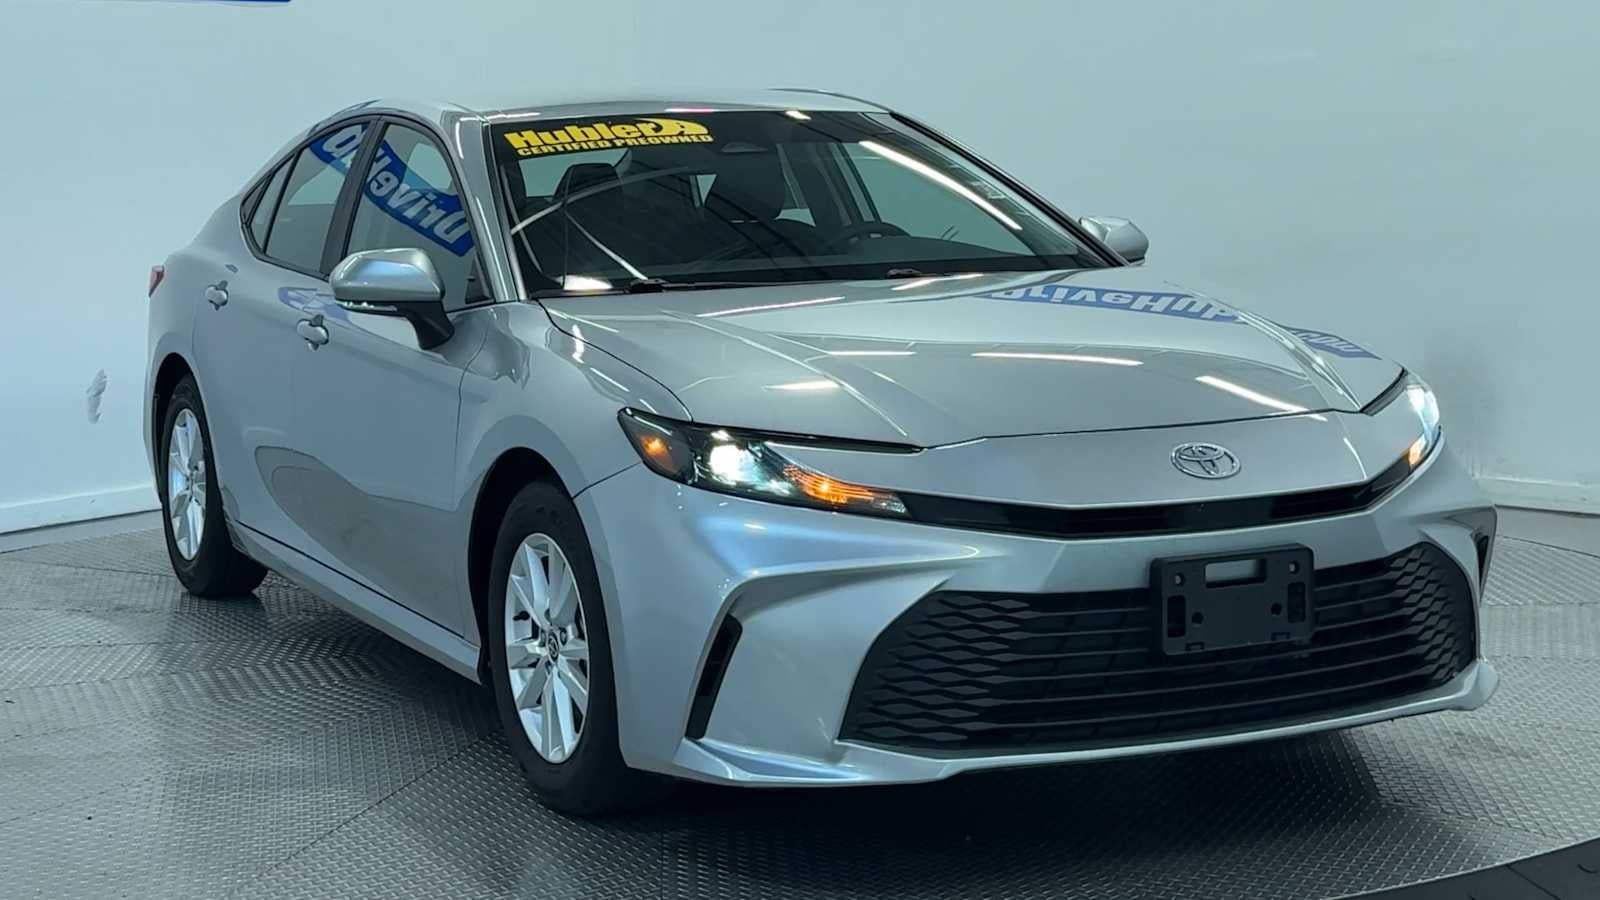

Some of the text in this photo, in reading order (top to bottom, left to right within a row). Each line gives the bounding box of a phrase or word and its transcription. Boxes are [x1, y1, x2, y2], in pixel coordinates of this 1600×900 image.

[504, 122, 656, 149] Hubler
[516, 133, 714, 156] CERTIFIED PREOWNED
